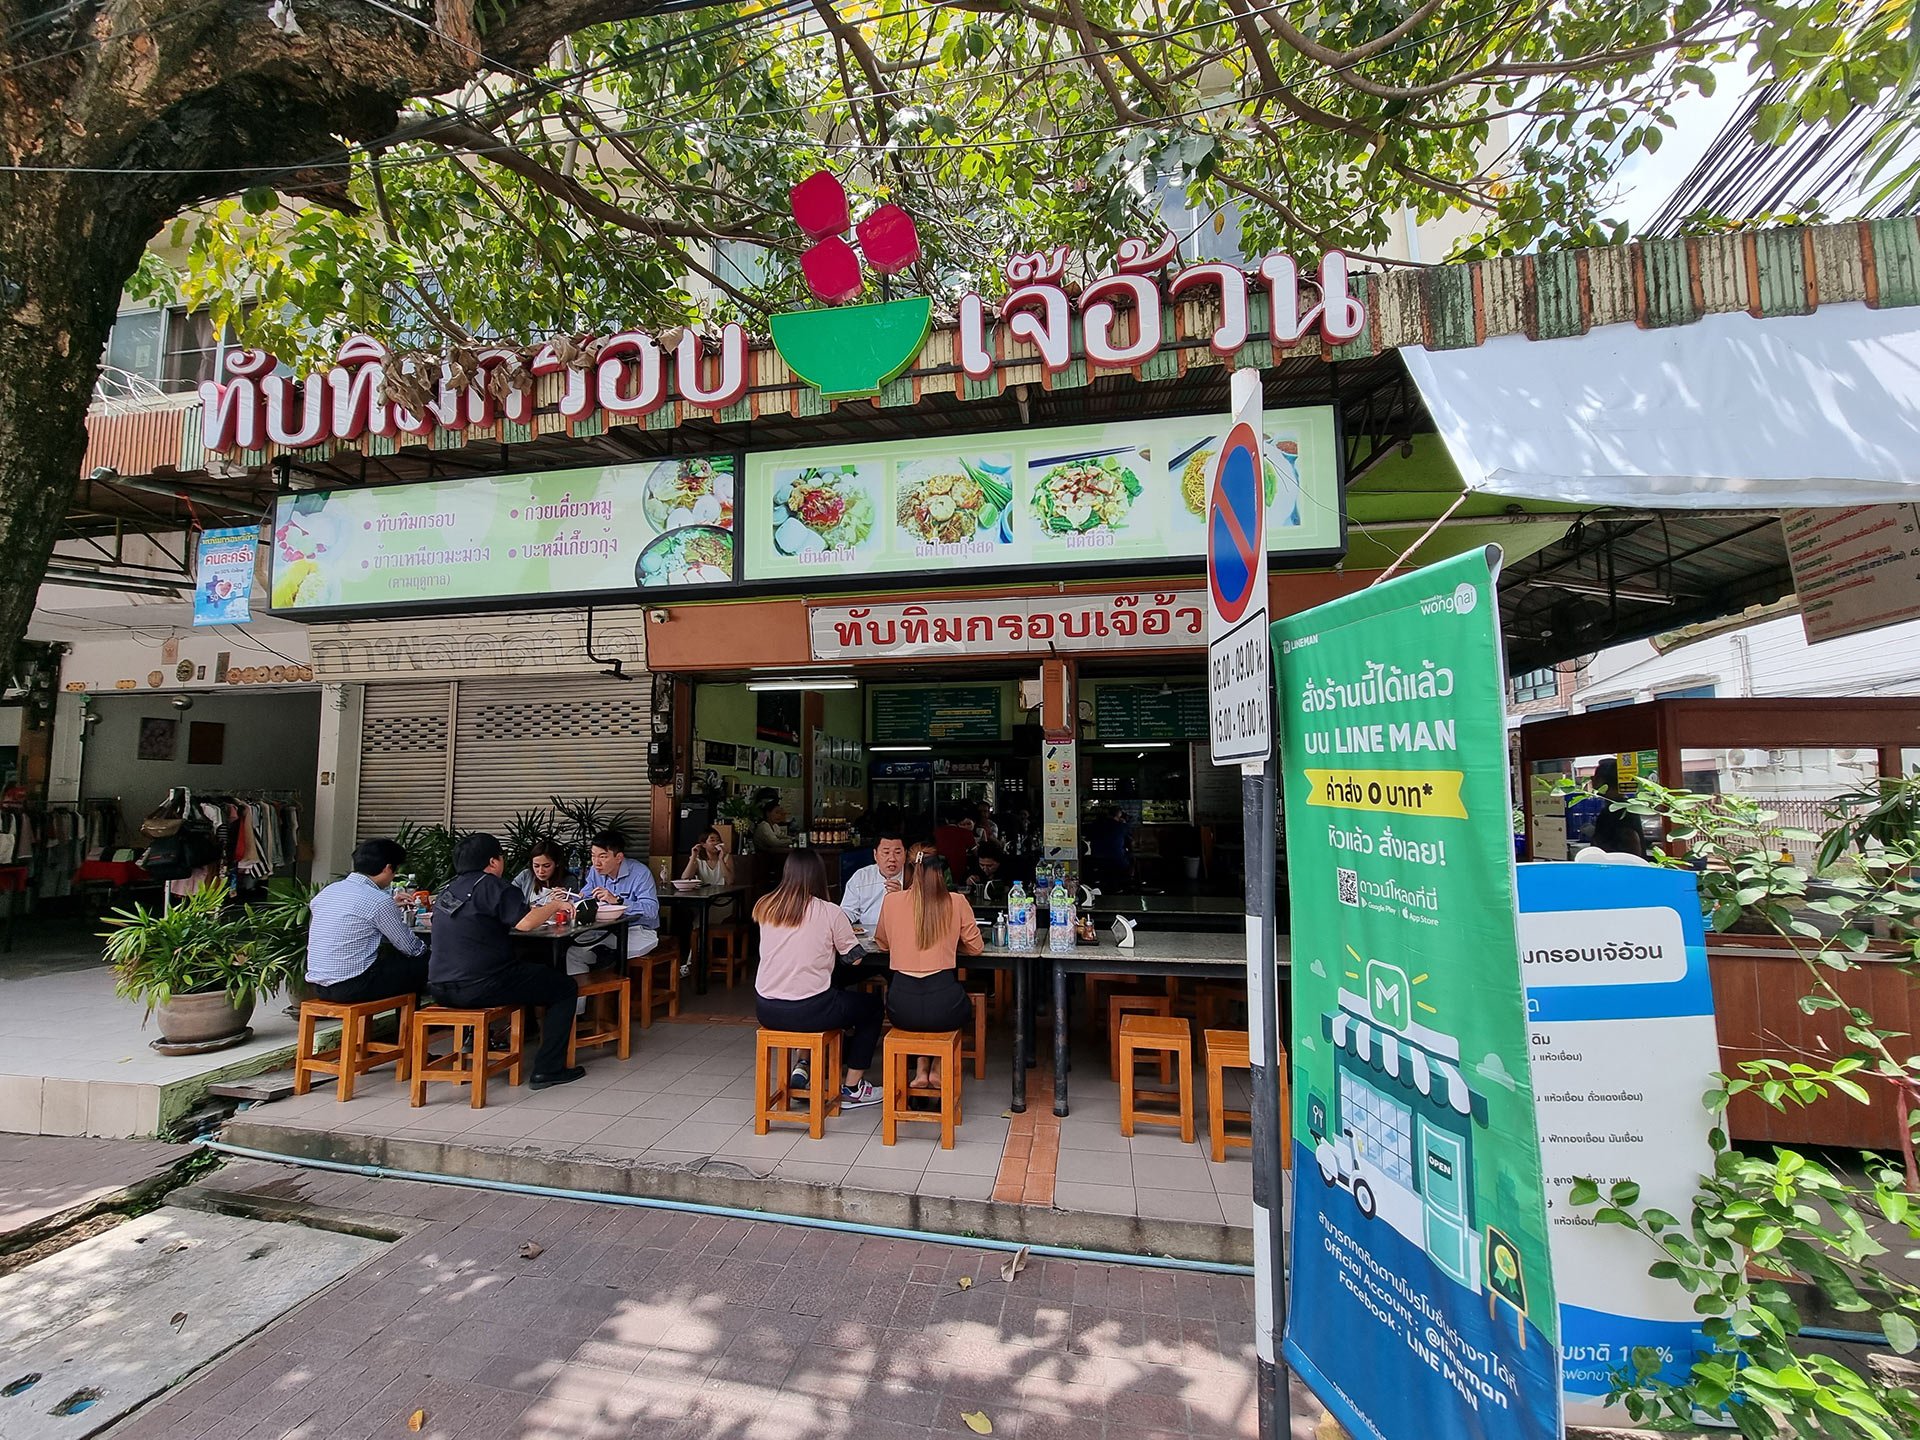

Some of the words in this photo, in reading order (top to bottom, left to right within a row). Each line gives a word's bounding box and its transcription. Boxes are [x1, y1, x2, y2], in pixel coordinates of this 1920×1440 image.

[959, 229, 1366, 380] เจ๊อ้วน
[376, 512, 456, 533] ทับทิมกรอบ
[373, 537, 491, 569] ข้าวเหนียวมะม่วง
[521, 526, 619, 559] บะหมี่เกี๊ยวกุ้ง
[1420, 587, 1474, 616] wongnai
[834, 594, 1203, 648] ทับทิมกรอบเจ๊อ้ว
[1236, 639, 1255, 682] 09.00
[1301, 659, 1454, 713] สั่งร้านนี้ได้แล้ว
[1215, 706, 1231, 743] 15.00
[1237, 698, 1256, 738] 18.00
[1304, 731, 1329, 754] บน
[1335, 724, 1385, 754] LINE
[1389, 719, 1457, 752] MAN
[1326, 776, 1362, 803] ค่าส่ง
[1368, 782, 1382, 805] 0
[1328, 824, 1374, 854] หิวแล้ว
[1378, 826, 1447, 866] สั่งเลย!
[1360, 878, 1438, 911] ดาวน์โหลดที่นี่
[1367, 901, 1385, 913] Google
[1385, 905, 1397, 916] Play
[1409, 912, 1421, 923] App
[1420, 915, 1440, 926] Store
[1539, 1049, 1583, 1062] แห้วเชื่อม)
[1544, 1091, 1584, 1102] แห้วเชื่อม
[1587, 1090, 1644, 1103] ถั่วแดงเชื่อม)
[1548, 1132, 1605, 1143] ฟักทองเชื่อม
[1608, 1131, 1644, 1143] มันเชื่อม
[1429, 1155, 1451, 1175] OPEN
[1324, 1237, 1362, 1279] Official
[1363, 1273, 1413, 1326] Account
[1425, 1327, 1508, 1410] @lineman
[1339, 1270, 1396, 1331] Facebook
[1407, 1330, 1440, 1372] LINE
[1443, 1362, 1479, 1412] MAN
[1619, 1345, 1674, 1364] 1%
[1561, 1368, 1611, 1382] รฟอกขา
